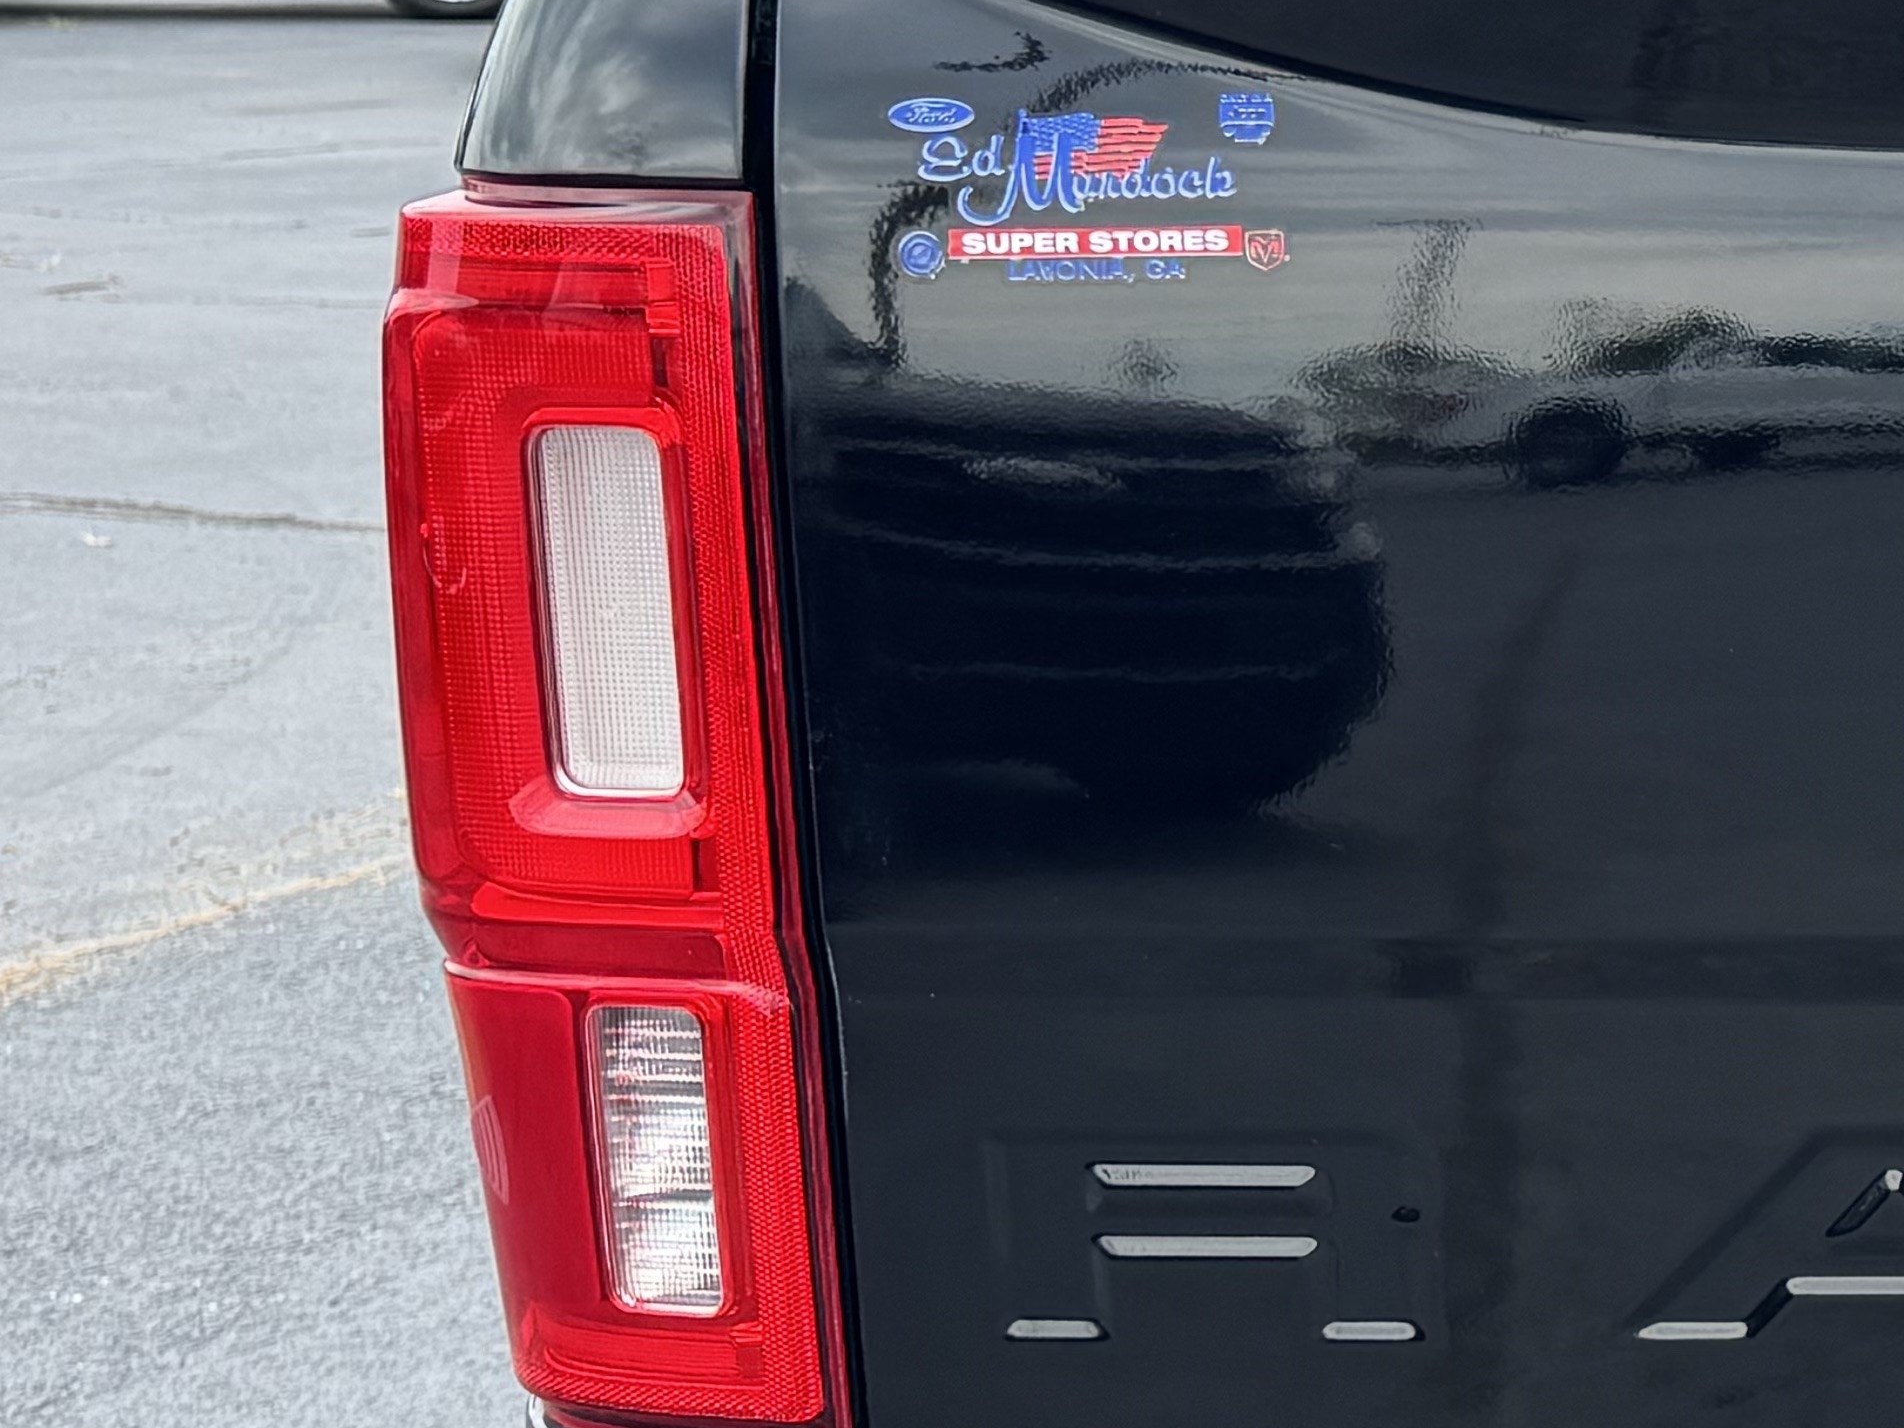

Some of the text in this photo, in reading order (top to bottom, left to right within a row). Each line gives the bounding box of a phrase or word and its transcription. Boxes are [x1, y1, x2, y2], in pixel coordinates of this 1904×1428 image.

[917, 133, 1238, 226] Ed Murdock
[961, 229, 1230, 255] SUPER STORES
